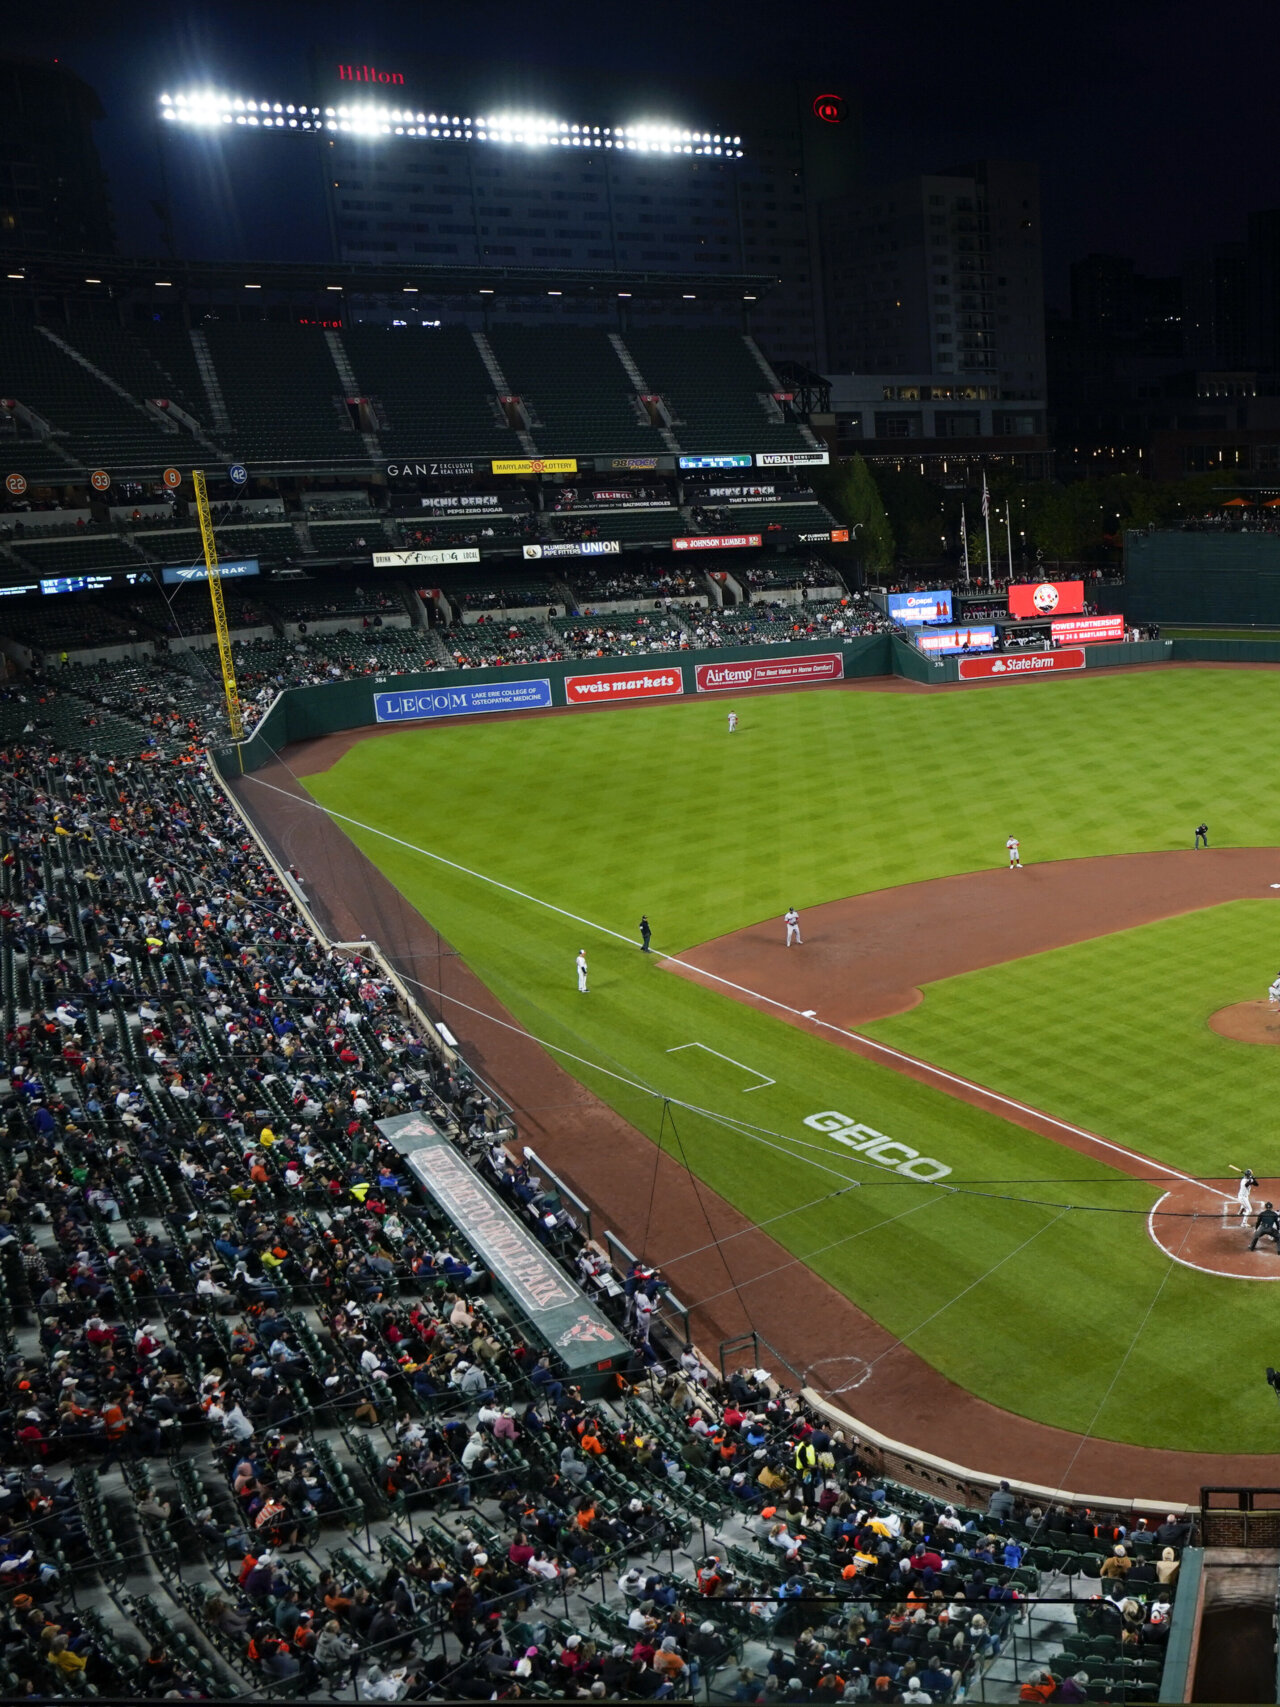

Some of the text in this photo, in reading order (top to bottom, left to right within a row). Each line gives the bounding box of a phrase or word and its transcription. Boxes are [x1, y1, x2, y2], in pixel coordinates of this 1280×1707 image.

[338, 64, 405, 85] Hilton
[280, 219, 316, 230] 2 Hopkins
[612, 459, 627, 467] 98
[627, 458, 658, 467] ROCK
[763, 455, 793, 464] WBAL
[232, 468, 246, 481] 42
[387, 464, 439, 476] GANZ
[10, 476, 24, 490] 22
[94, 475, 108, 487] 33
[169, 472, 176, 484] 8
[709, 488, 741, 496] PICNIC
[421, 496, 498, 507] PICNIC PERCH
[582, 541, 619, 553] UNION
[690, 537, 746, 547] JOHNSON LUMBER
[463, 551, 477, 559] LOCAL
[196, 566, 245, 577] AMTRAK
[915, 597, 933, 605] pepsi
[1076, 618, 1121, 628] PARTNERSHIP
[706, 669, 752, 684] Airtemp
[575, 675, 674, 694] weis markets
[501, 689, 528, 697] COLLEGE
[472, 694, 541, 706] OSTEOPATHIC MEDICINE
[802, 1110, 953, 1182] GEICO
[422, 1148, 568, 1306] WELCOME TO ORIOLE PARK
